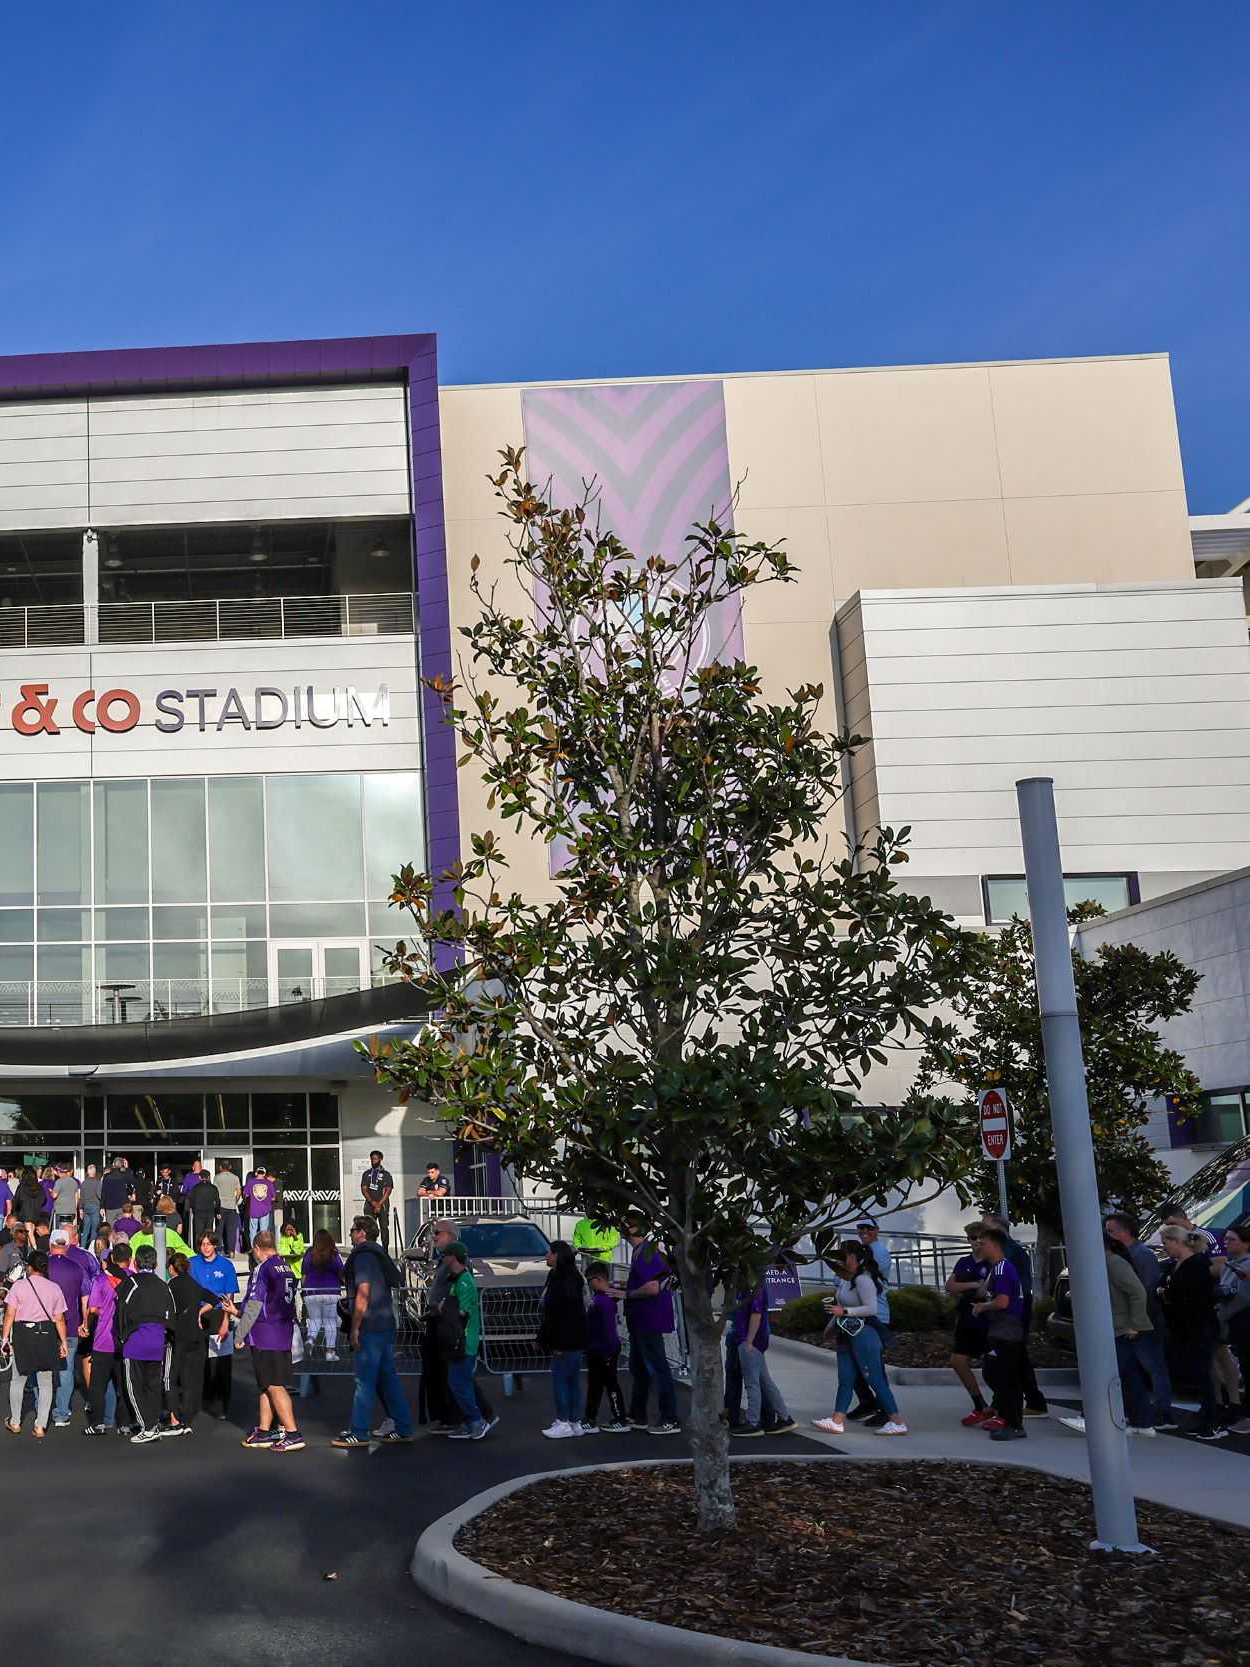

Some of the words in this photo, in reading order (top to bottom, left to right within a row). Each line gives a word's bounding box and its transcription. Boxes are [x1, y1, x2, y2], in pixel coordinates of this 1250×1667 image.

[11, 684, 61, 736] &
[154, 682, 391, 734] STADIUM
[983, 1104, 991, 1115] DO
[992, 1103, 1003, 1113] NOT
[987, 1134, 1004, 1146] ENTER
